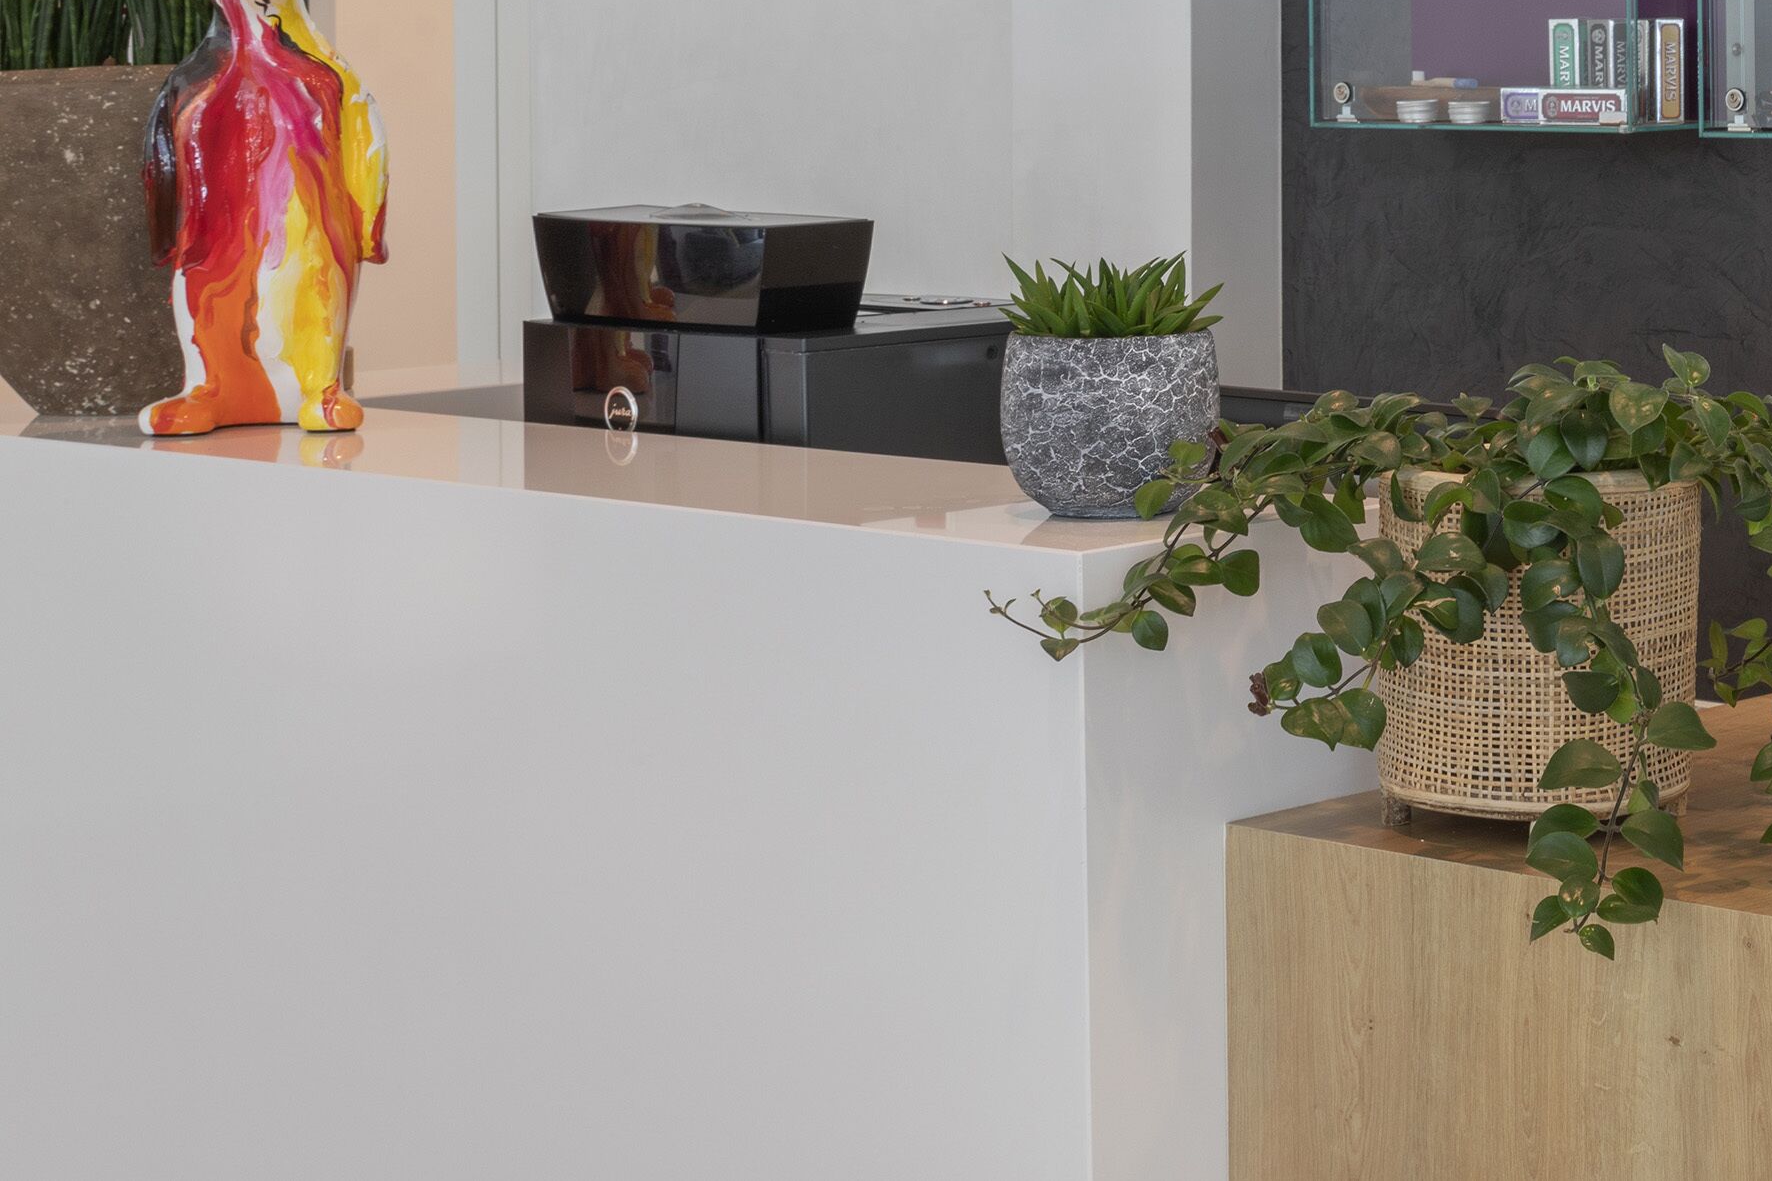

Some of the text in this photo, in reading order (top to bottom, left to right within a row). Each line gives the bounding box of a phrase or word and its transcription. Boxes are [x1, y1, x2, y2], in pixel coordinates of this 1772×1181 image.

[1664, 42, 1677, 103] MARVIS
[1560, 100, 1617, 113] MARVIS
[608, 403, 633, 419] jura
